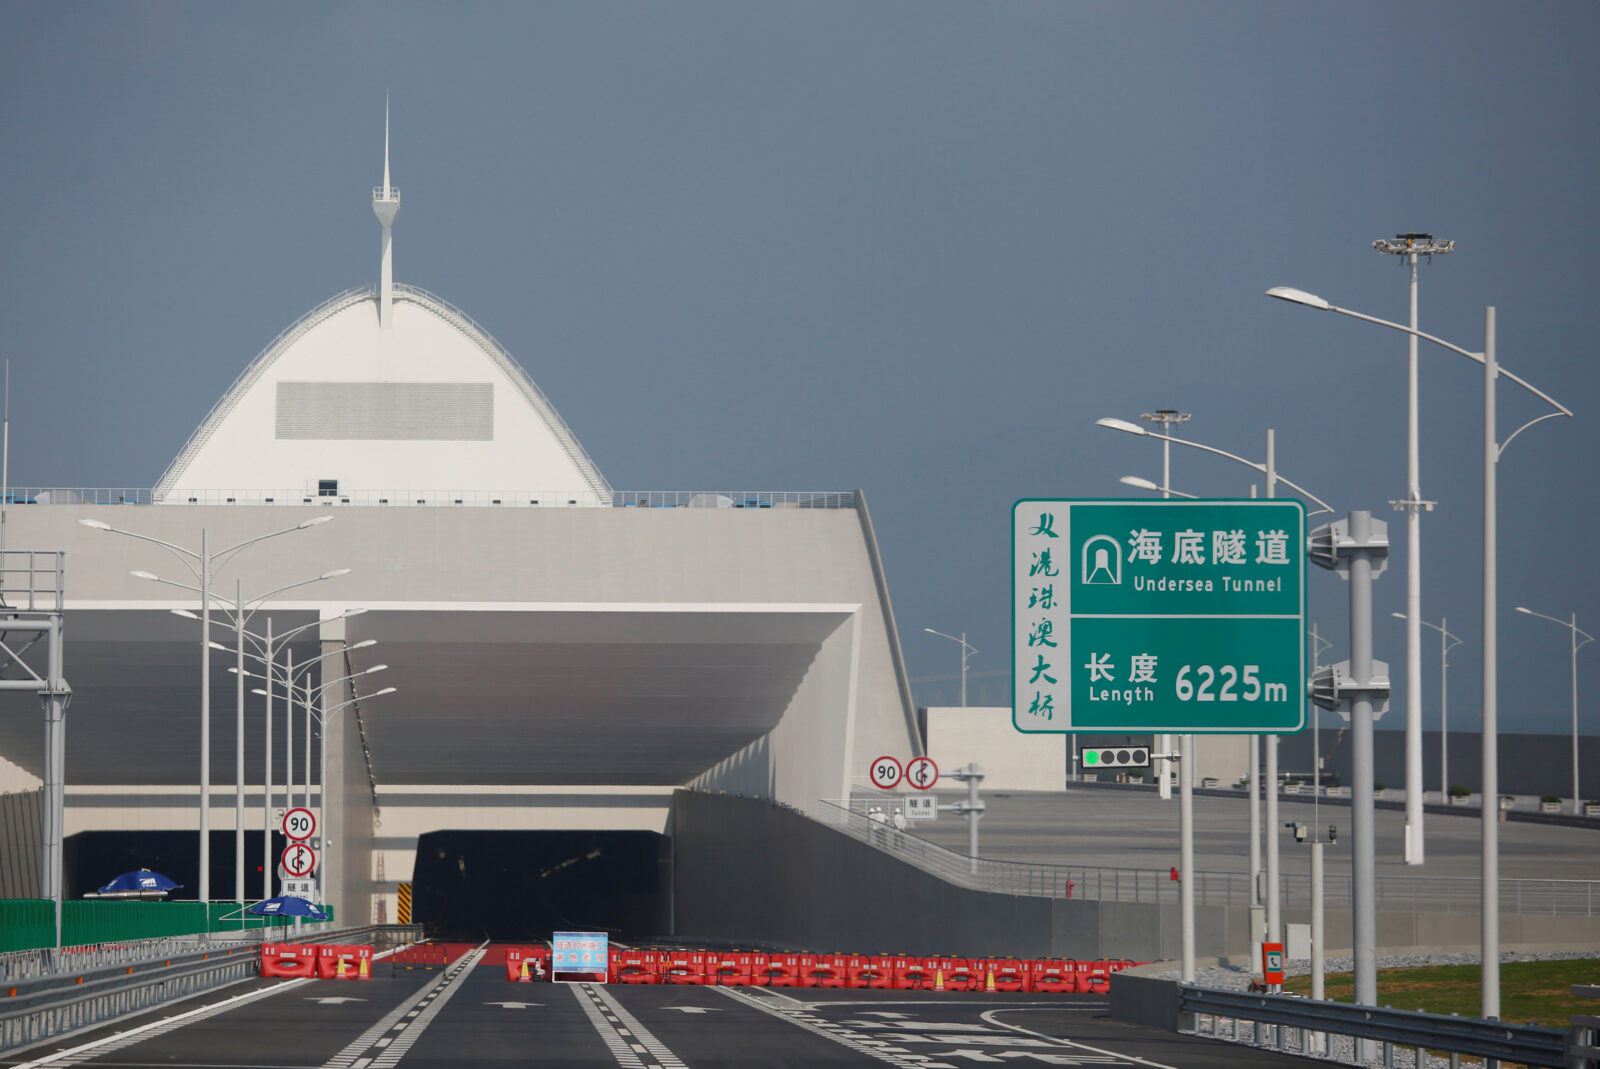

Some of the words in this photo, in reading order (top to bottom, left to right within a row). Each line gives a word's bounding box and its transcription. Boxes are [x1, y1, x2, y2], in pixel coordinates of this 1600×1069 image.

[1127, 528, 1290, 565] 海底隧道
[1134, 575, 1213, 592] Undersea
[1222, 575, 1281, 592] Tunnel
[1084, 652, 1158, 683] 长度
[1175, 664, 1287, 702] 6225m
[1089, 686, 1154, 706] Length
[877, 765, 896, 780] 90
[290, 817, 309, 832] 90
